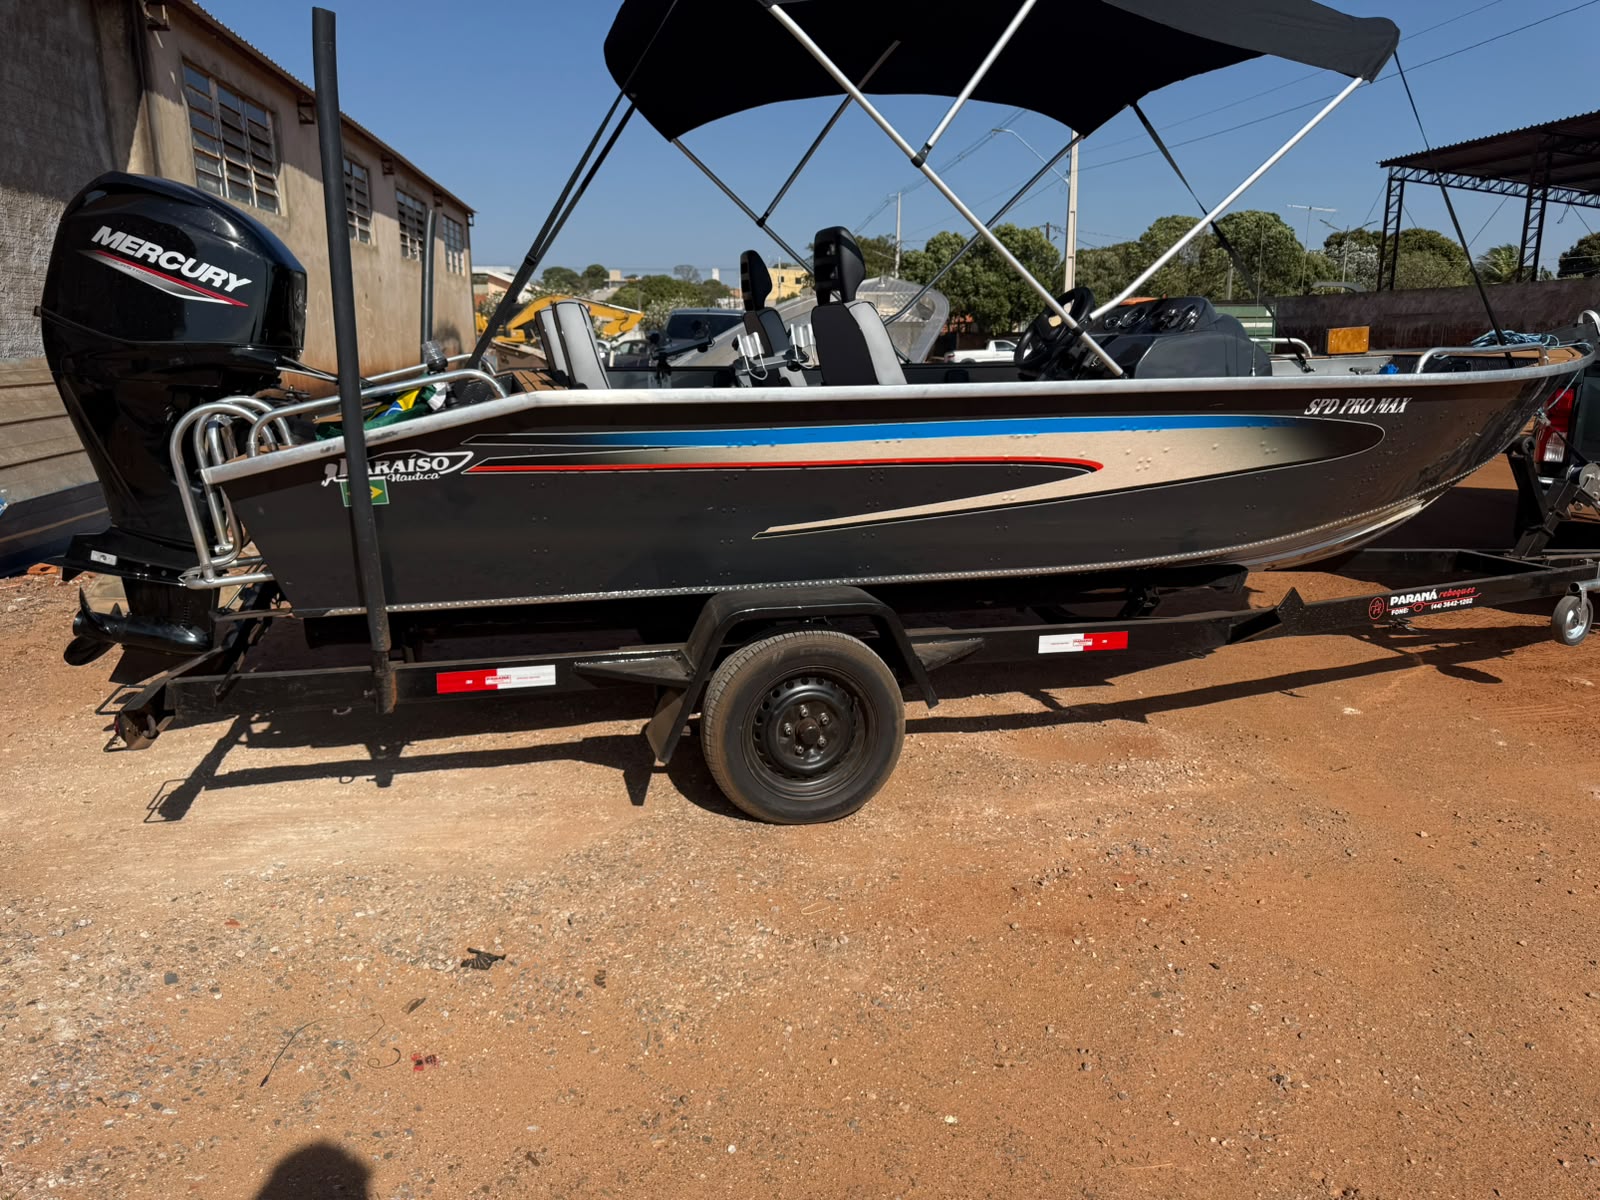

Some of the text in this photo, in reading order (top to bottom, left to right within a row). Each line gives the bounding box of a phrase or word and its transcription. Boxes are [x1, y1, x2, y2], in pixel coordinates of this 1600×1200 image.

[91, 225, 252, 293] MERCURY
[1304, 397, 1413, 415] SPD PRO MAX
[339, 453, 450, 477] RAÍSO
[1390, 587, 1476, 606] PARANÁ reboques
[1391, 608, 1409, 616] FONE:
